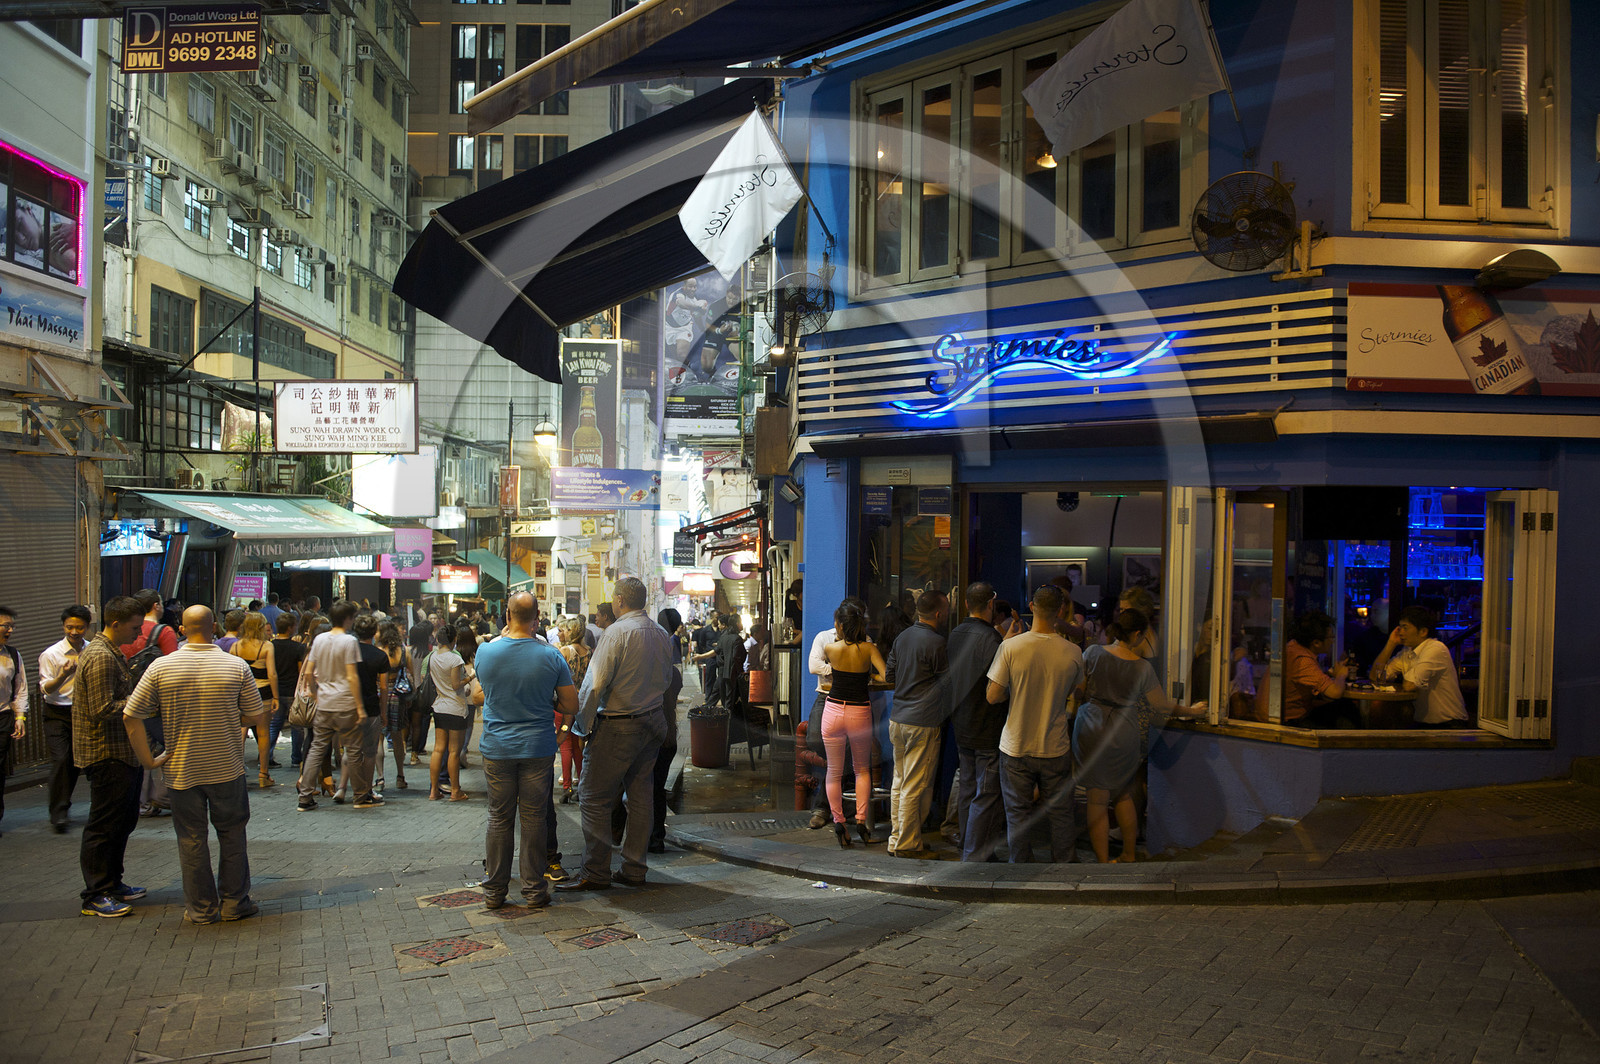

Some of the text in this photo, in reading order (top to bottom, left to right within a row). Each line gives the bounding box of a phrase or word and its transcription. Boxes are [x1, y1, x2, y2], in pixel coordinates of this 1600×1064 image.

[169, 10, 259, 22] Donald Wong Ltd.
[129, 12, 161, 47] D
[170, 30, 256, 45] AD HOTLINE
[127, 51, 161, 68] DWL
[168, 45, 257, 62] 9699 2348
[7, 306, 79, 344] Thai Massage
[1358, 327, 1438, 354] Stormies
[565, 358, 613, 373] LAN KWAI FONG
[925, 329, 1108, 395] Stormies
[577, 376, 599, 384] BEER
[1475, 354, 1526, 391] CANADIAN
[388, 427, 402, 435] CO.
[403, 559, 413, 568] 5E
